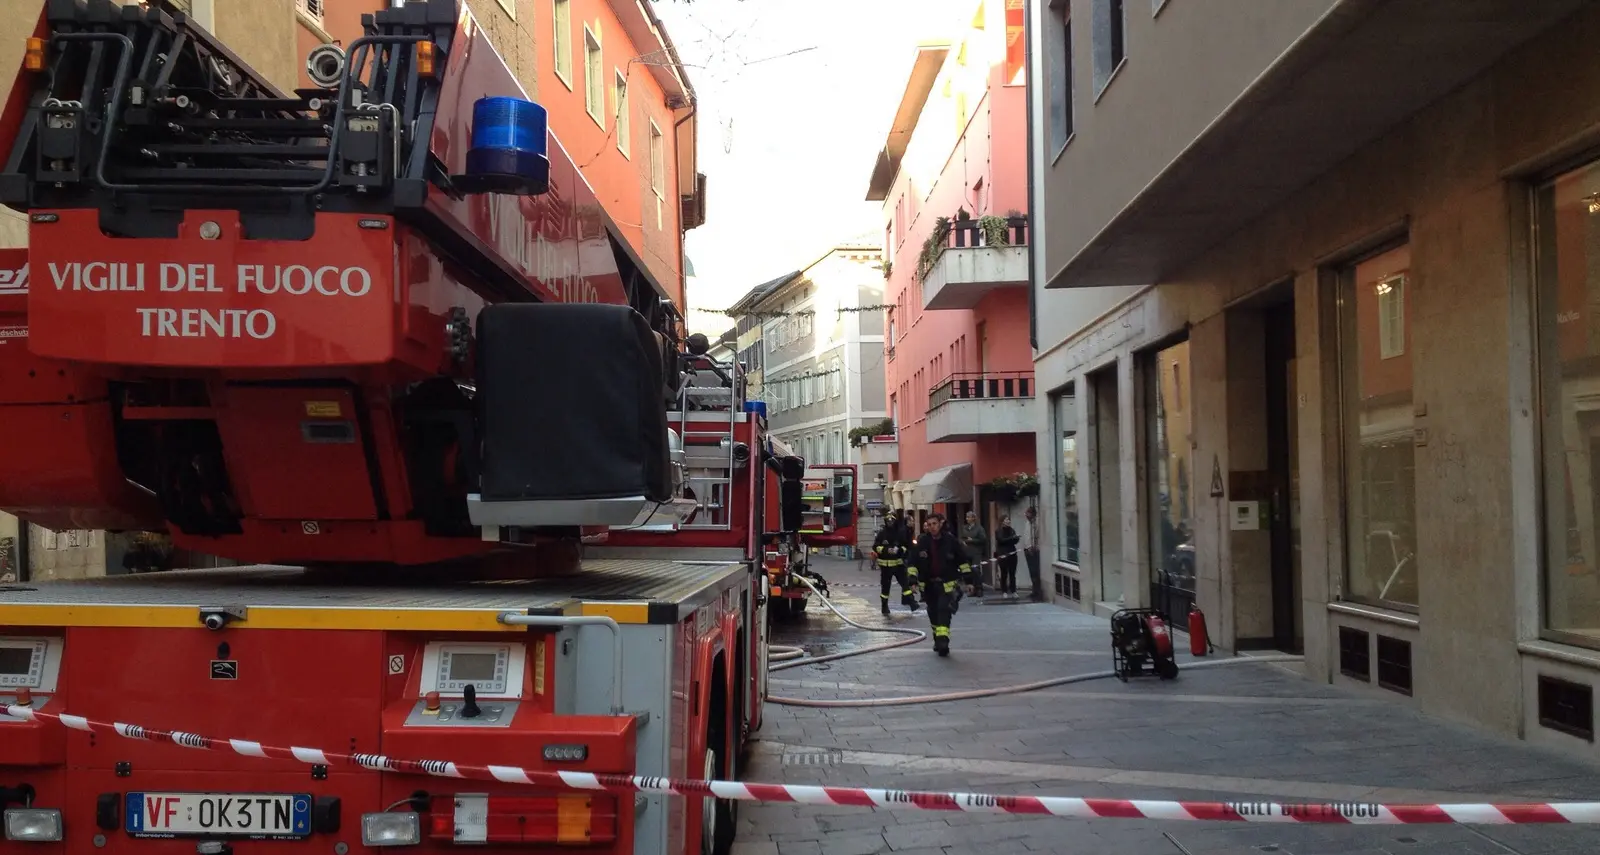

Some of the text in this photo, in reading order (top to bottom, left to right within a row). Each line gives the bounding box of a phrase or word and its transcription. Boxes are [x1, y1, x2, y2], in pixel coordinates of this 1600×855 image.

[48, 261, 372, 297] VIGILI DEL FUOCO
[136, 308, 277, 340] TRENTO
[146, 796, 181, 828] VF
